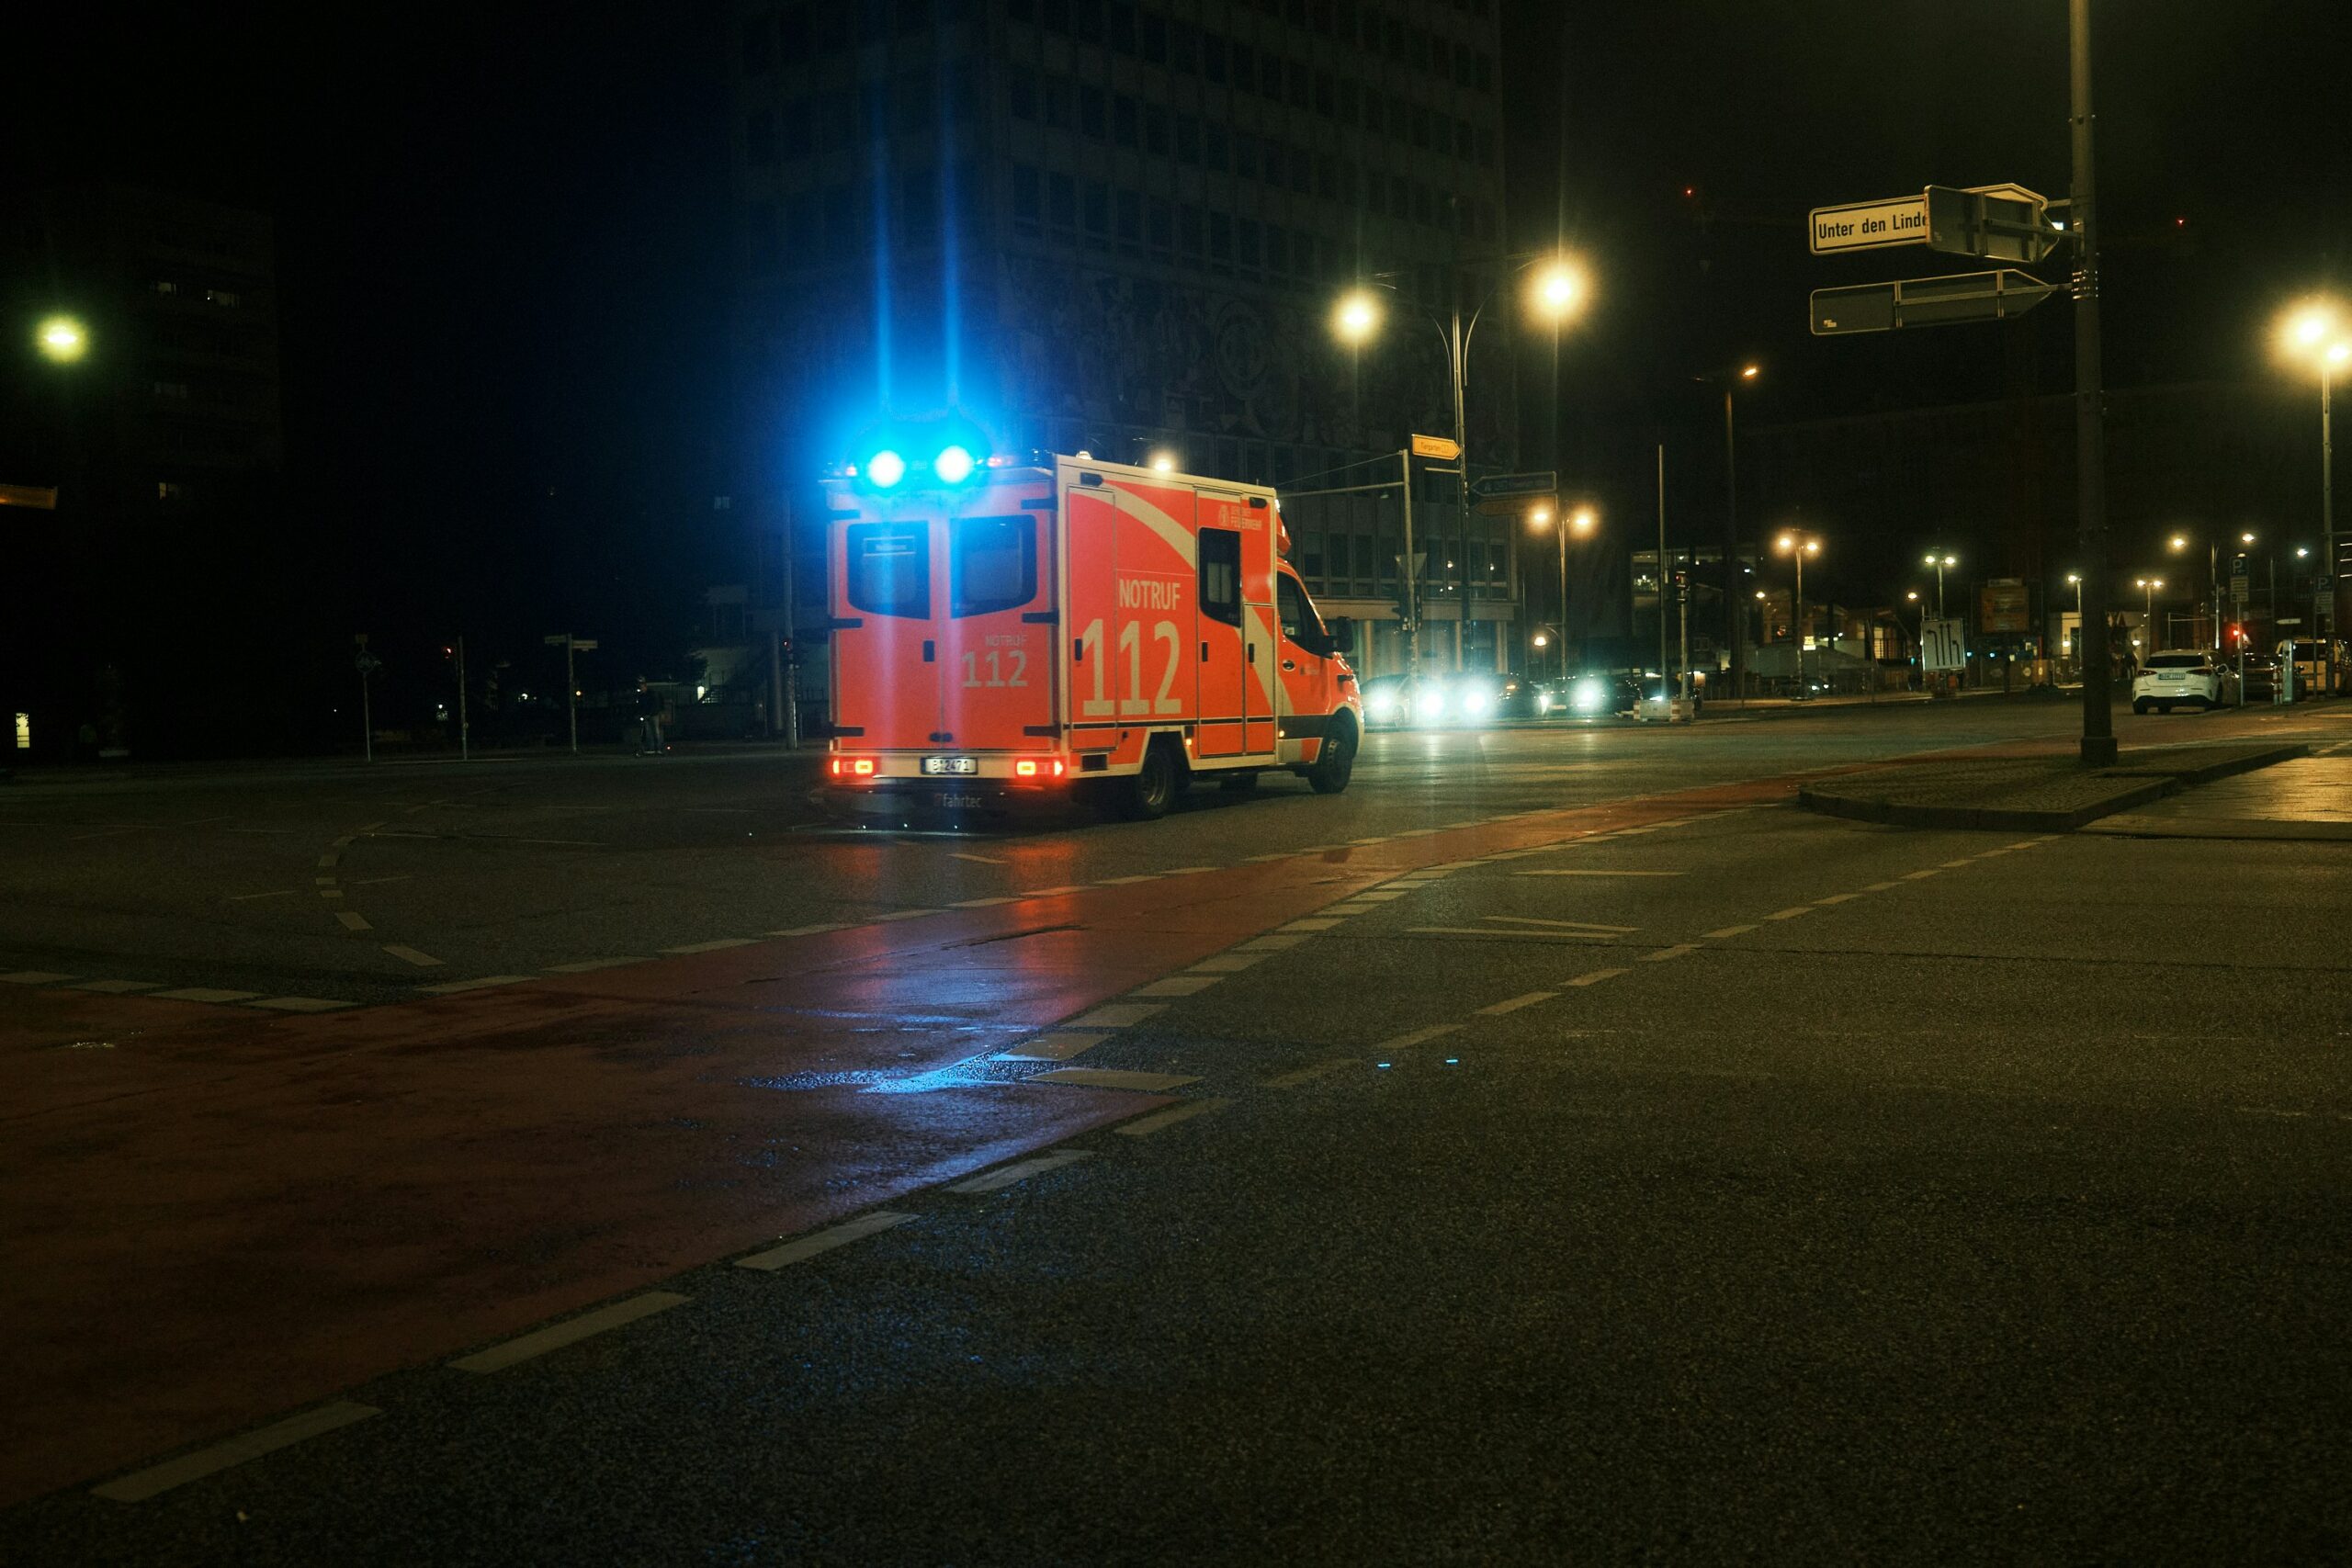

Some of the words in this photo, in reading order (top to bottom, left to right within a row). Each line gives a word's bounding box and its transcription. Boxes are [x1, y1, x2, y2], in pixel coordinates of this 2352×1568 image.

[1818, 223, 1854, 239] Unter
[1861, 219, 1886, 233] den
[1118, 579, 1182, 611] NOTRUF
[985, 635, 1028, 648] NOTRUF
[961, 649, 1029, 688] 112
[1081, 618, 1182, 716] 112
